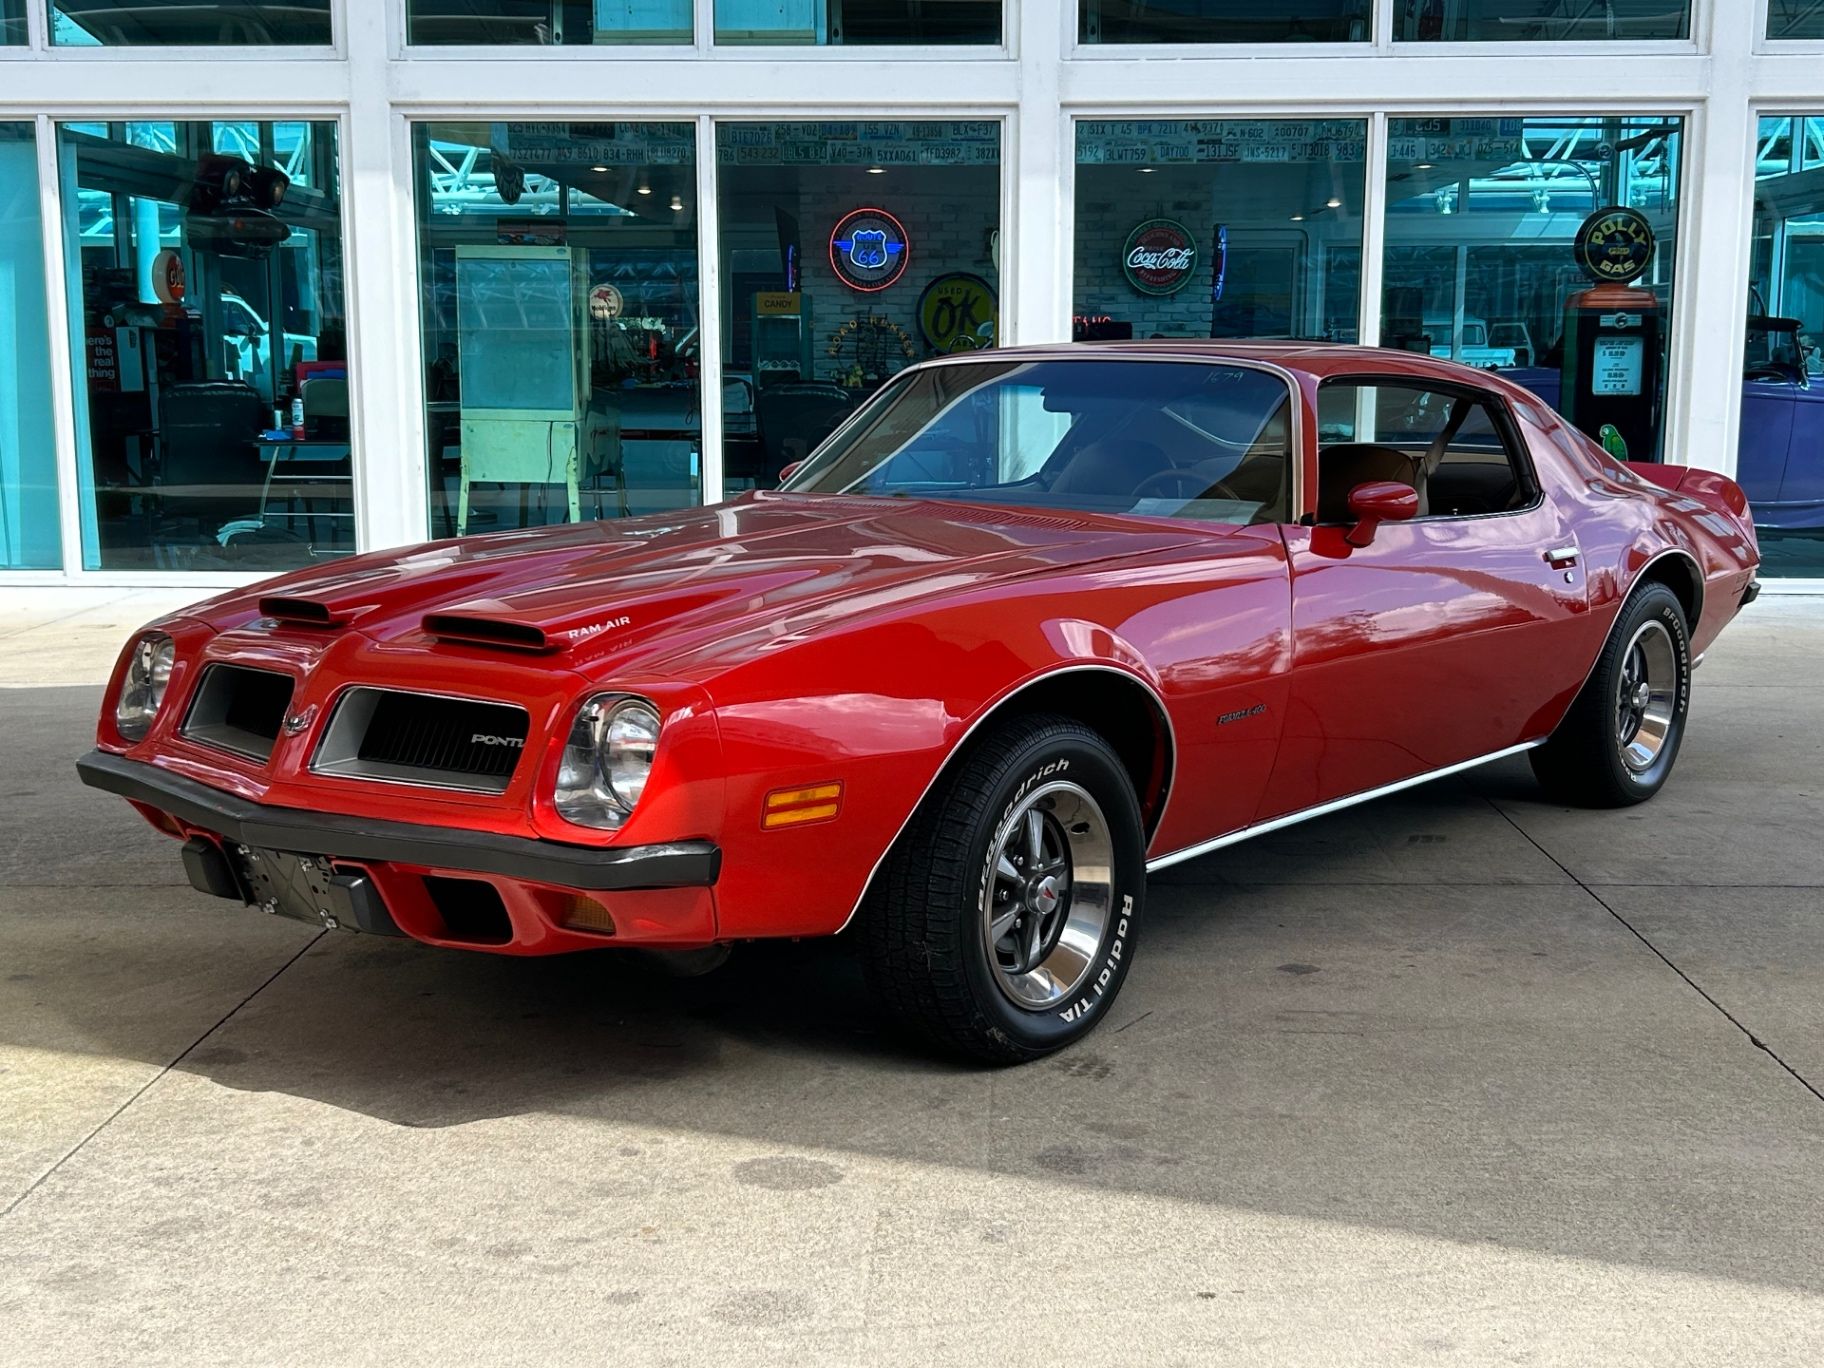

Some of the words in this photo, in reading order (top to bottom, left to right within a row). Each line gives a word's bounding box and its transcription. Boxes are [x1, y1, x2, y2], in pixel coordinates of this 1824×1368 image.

[857, 233, 883, 241] ROUTE
[1592, 218, 1648, 246] POLLY
[858, 249, 880, 265] 66
[1127, 246, 1195, 270] Coca-Cola
[1600, 259, 1636, 274] GAS
[937, 287, 962, 295] USED
[764, 299, 792, 309] CANDY
[932, 288, 981, 338] OK
[88, 335, 113, 346] ere's
[95, 346, 113, 357] the
[94, 356, 114, 367] real
[88, 367, 115, 379] thing
[568, 623, 602, 639] RAM
[605, 616, 631, 631] AIR
[1663, 606, 1688, 713] BFGoodrich
[1093, 894, 1134, 998] Radial
[1059, 996, 1094, 1024] T/A
